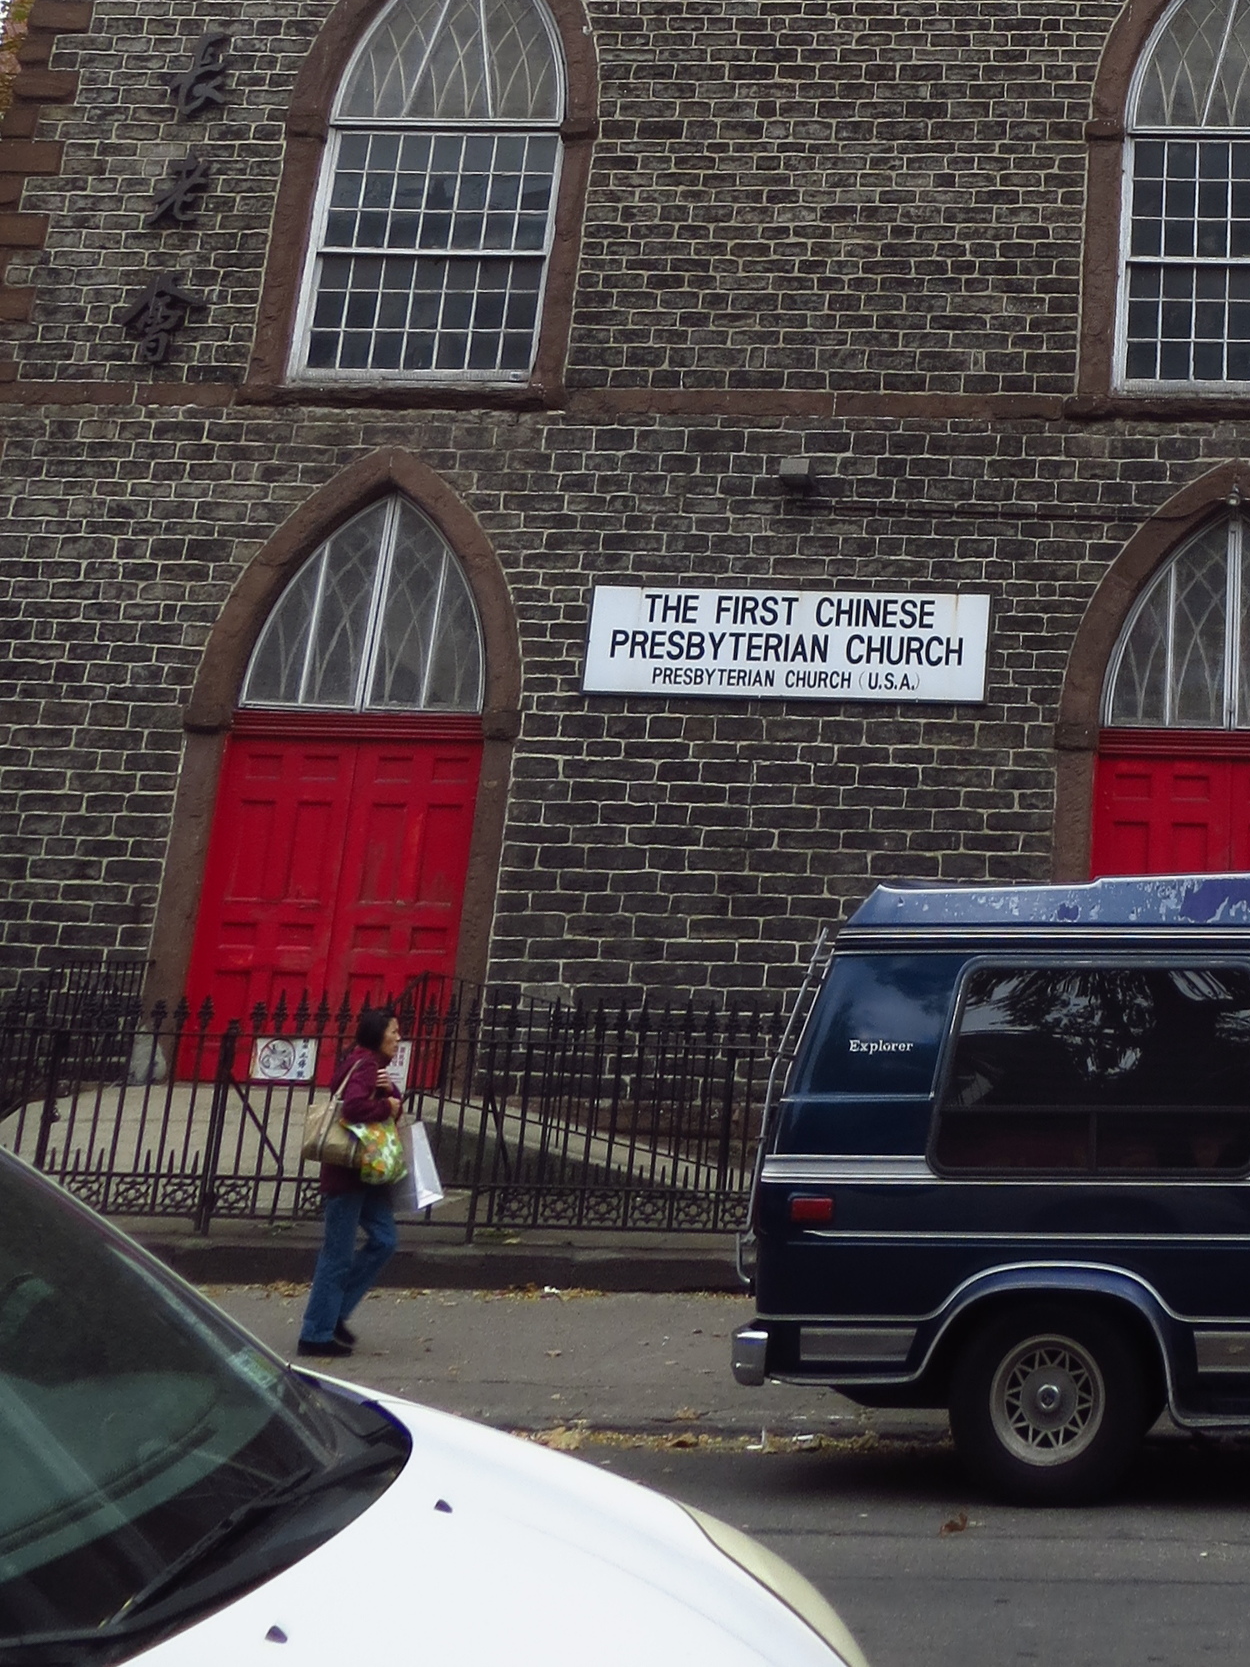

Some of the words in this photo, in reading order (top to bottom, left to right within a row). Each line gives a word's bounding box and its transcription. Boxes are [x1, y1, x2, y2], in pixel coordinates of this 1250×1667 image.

[644, 593, 700, 624] THE
[715, 595, 800, 626] FIRST
[815, 596, 936, 629] CHINESE
[609, 629, 829, 663] PRESBYTERIAN
[846, 634, 964, 667] CHURCH
[652, 667, 775, 688] PRESBYTERIAN
[785, 669, 852, 690] CHURCH
[858, 671, 921, 691] (U.S.A.)
[848, 1039, 914, 1055] Explorer
